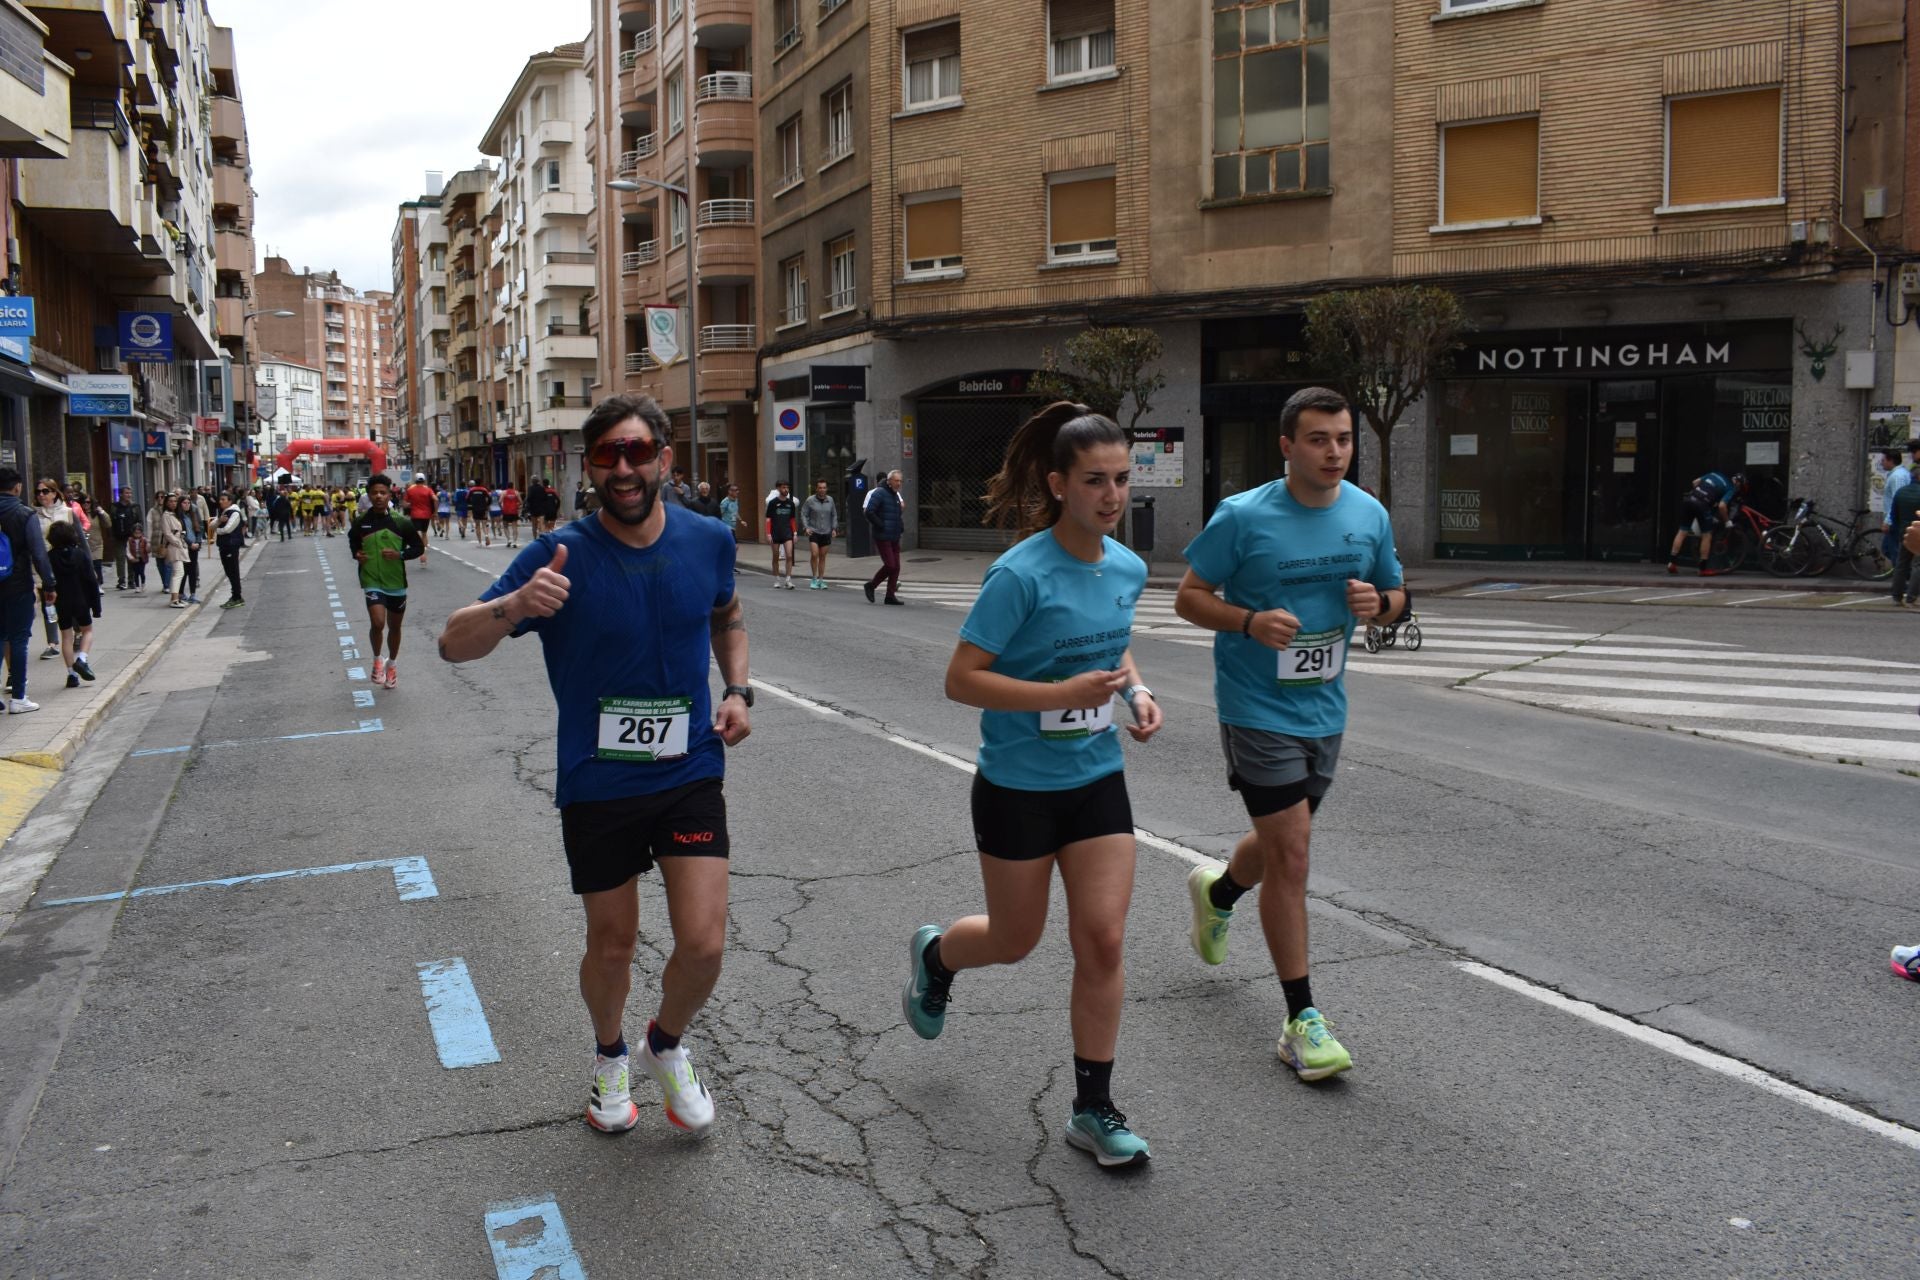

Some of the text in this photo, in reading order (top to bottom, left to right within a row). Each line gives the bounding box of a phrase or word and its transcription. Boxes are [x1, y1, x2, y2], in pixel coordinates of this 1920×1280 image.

[1479, 342, 1730, 371] NOTTINGHAM
[958, 379, 1003, 393] Bebricio
[1511, 395, 1551, 410] PRECIOS
[1743, 389, 1790, 406] PRECIOS
[1441, 492, 1480, 508] PRECIOS
[1278, 557, 1316, 570] CARRERA
[1318, 556, 1329, 566] DE
[1055, 634, 1094, 650] CARRERA
[1095, 632, 1105, 643] DE
[1295, 645, 1333, 673] 291
[618, 717, 673, 744] 267
